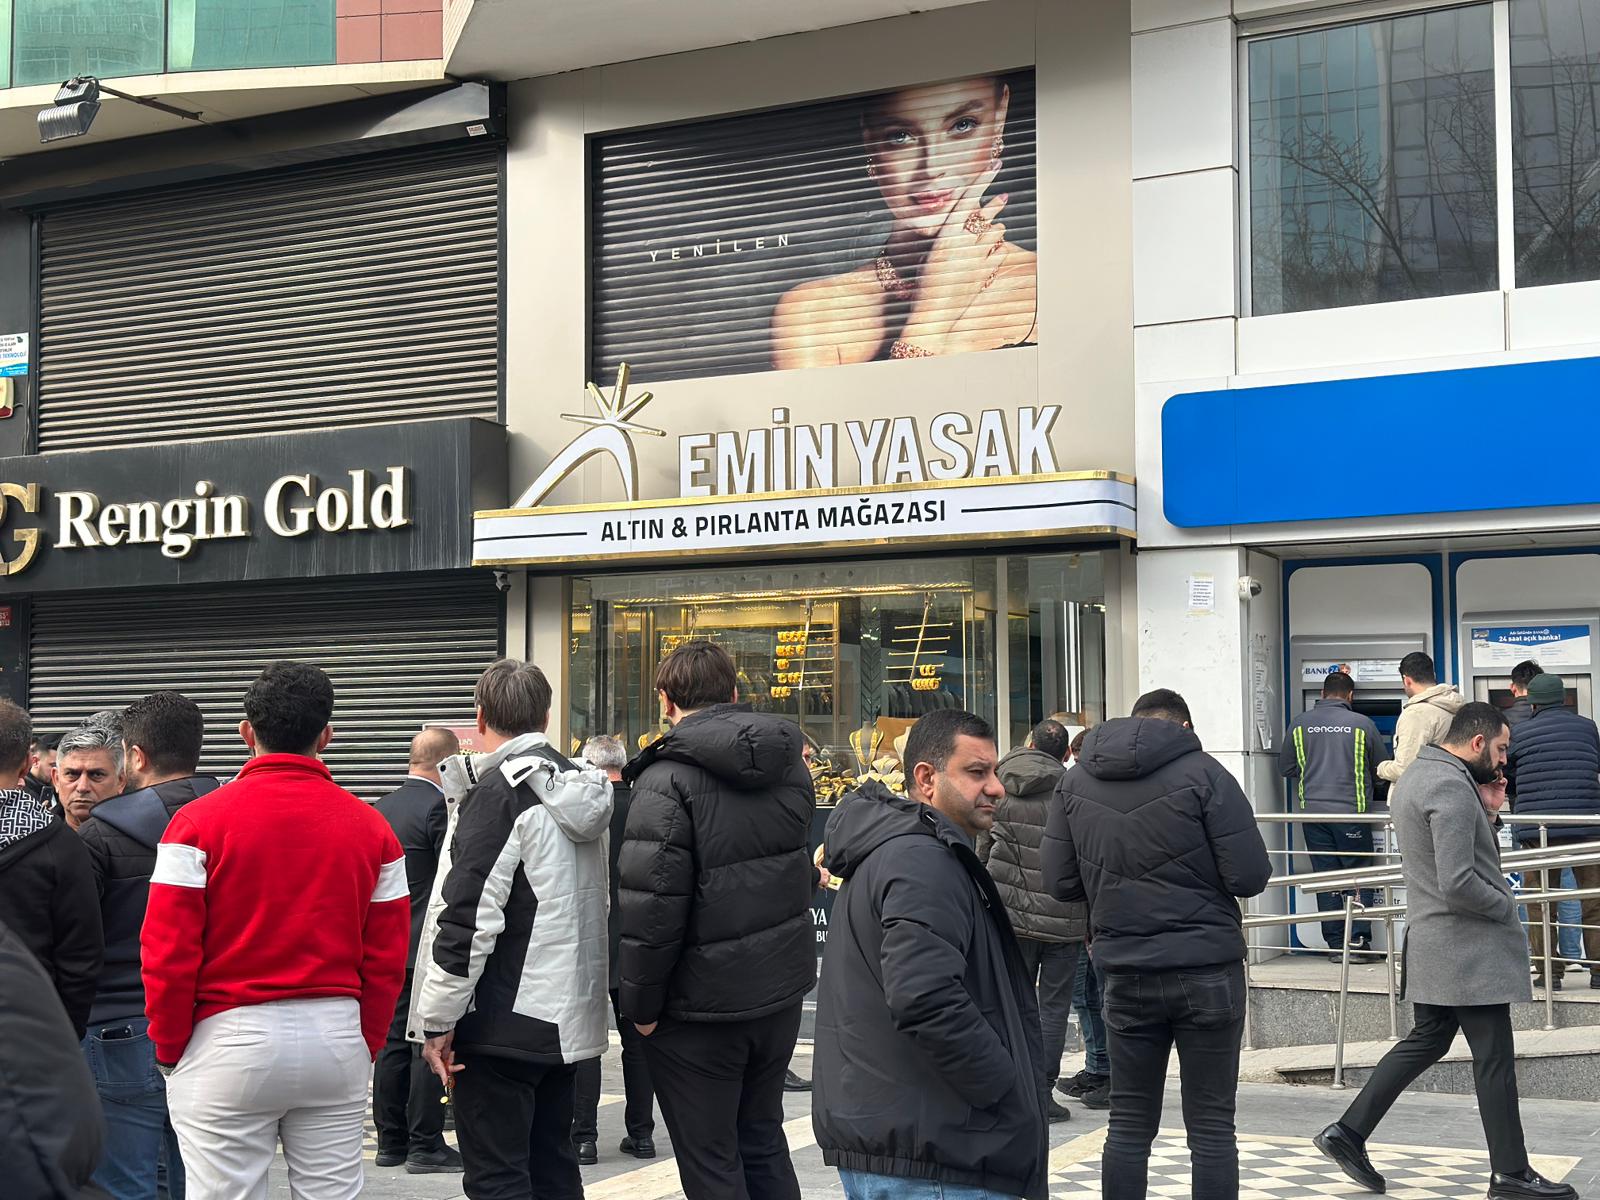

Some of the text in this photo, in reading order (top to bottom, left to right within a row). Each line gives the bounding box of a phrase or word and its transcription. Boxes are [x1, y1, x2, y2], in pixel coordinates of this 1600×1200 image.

[650, 234, 789, 262] YENİLEN
[678, 405, 1062, 498] EMİN YASAK
[53, 466, 412, 558] Rengin Gold
[601, 496, 946, 542] ALTIN & PIRLANTA MAĞAZASI
[1523, 635, 1537, 643] açık
[1537, 633, 1560, 641] banka!
[1305, 667, 1328, 675] BANK
